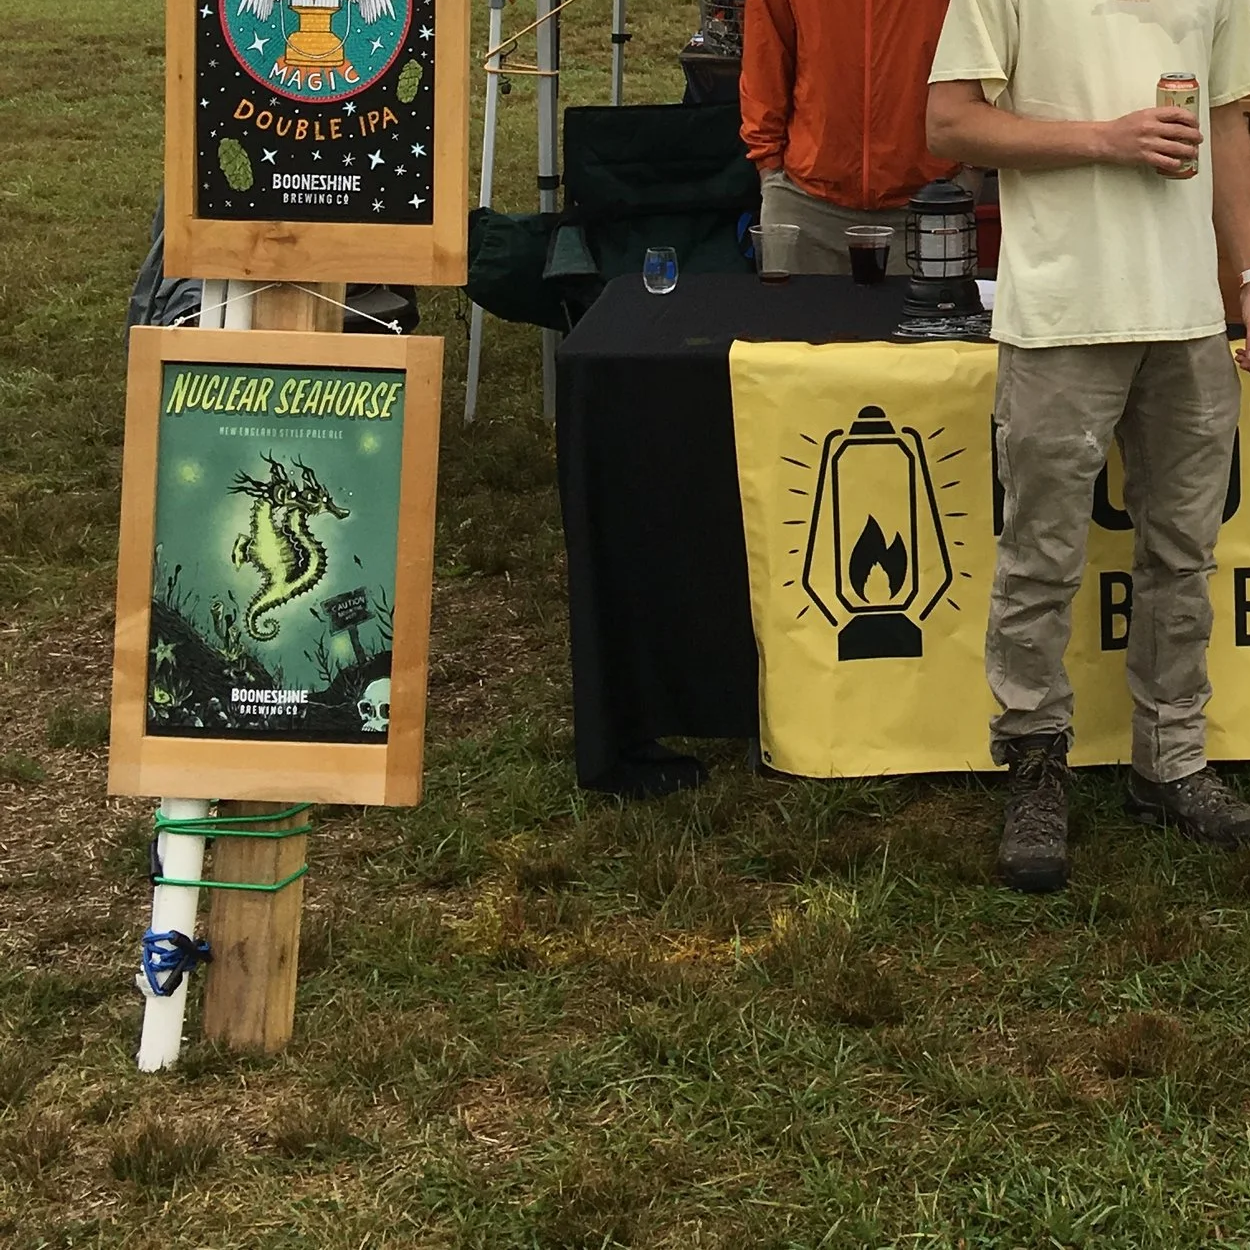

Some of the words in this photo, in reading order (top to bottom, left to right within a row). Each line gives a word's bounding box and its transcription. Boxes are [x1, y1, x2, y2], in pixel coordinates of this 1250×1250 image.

[268, 62, 360, 91] MAGIC
[233, 98, 343, 141] DOUBLE
[358, 106, 399, 138] IPA
[272, 173, 361, 191] BOONESHINE
[283, 193, 332, 204] BREWING
[166, 373, 272, 417] NUCLEAR
[273, 379, 402, 420] SEAHORSE
[240, 427, 277, 437] ENGLAND
[280, 428, 304, 438] STYLE
[306, 429, 326, 439] PALE
[329, 430, 343, 439] ALE
[331, 596, 365, 612] CAUTION
[231, 688, 309, 704] BOONESHINE
[240, 705, 283, 715] BREWING
